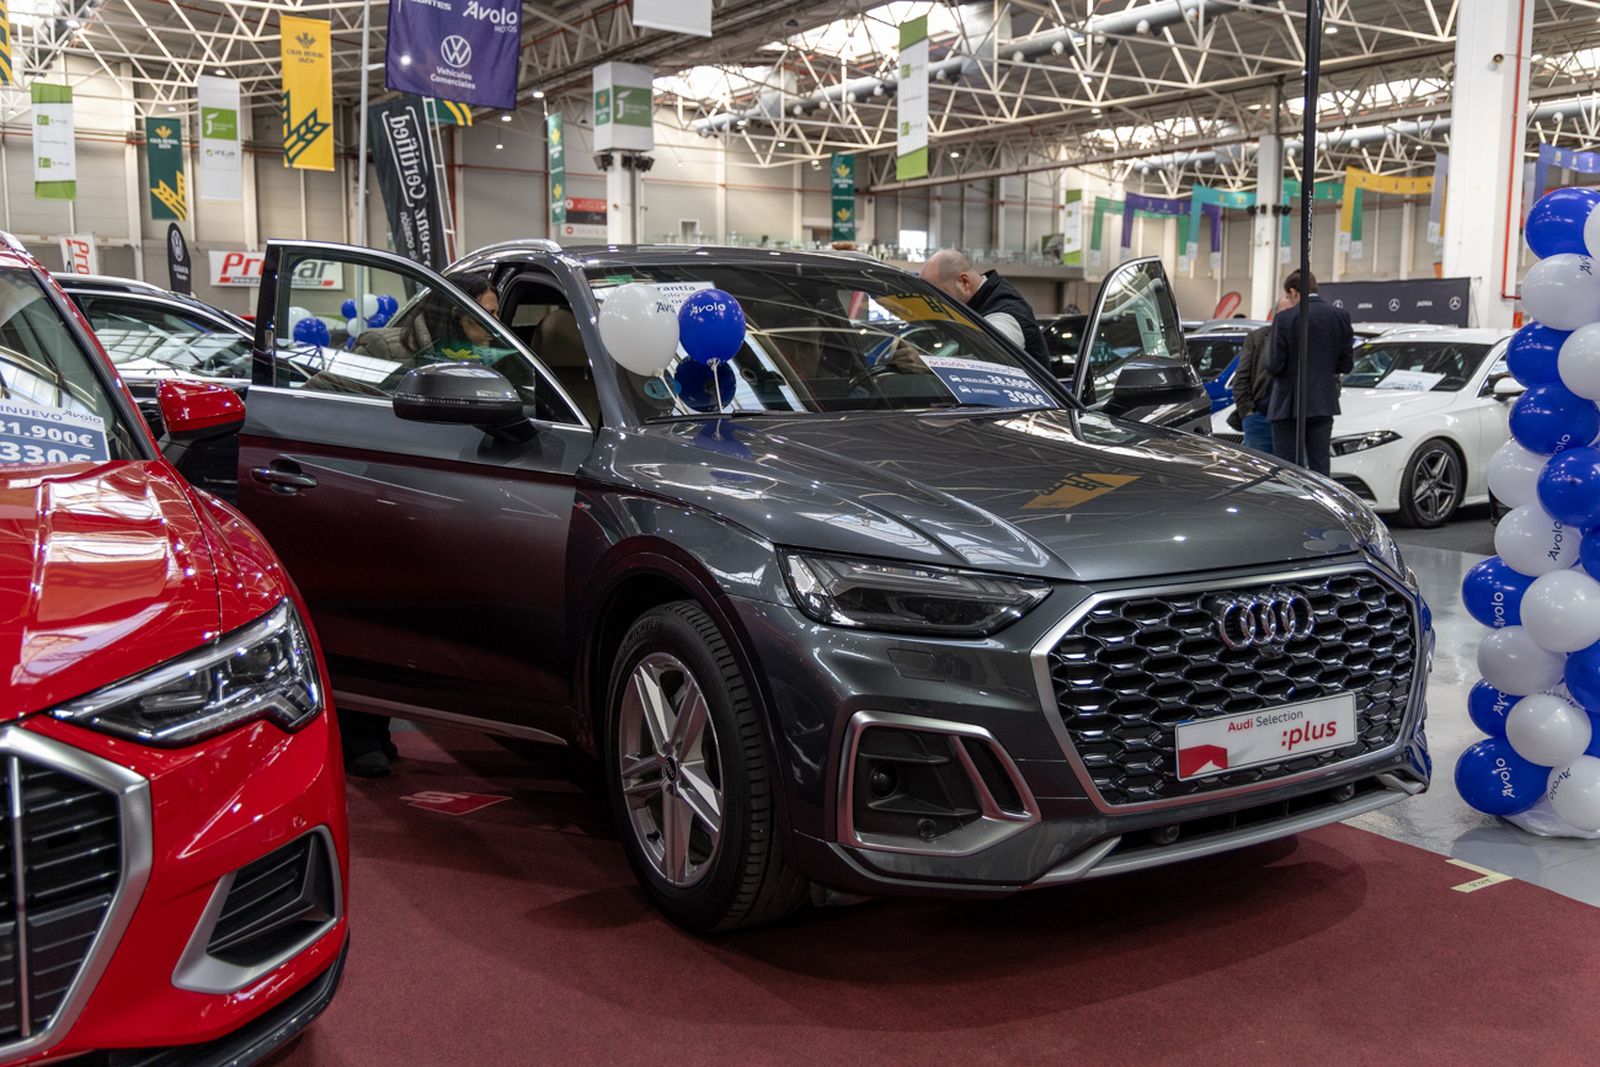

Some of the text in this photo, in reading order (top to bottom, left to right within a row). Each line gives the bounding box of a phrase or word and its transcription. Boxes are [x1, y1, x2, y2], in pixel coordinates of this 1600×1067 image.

[430, 73, 476, 90] Comerciales
[690, 302, 726, 317] Avolo
[1003, 389, 1051, 407] 398€
[1548, 433, 1571, 457] volo
[1228, 710, 1304, 733] Audi Selection
[1281, 720, 1337, 751] :plus
